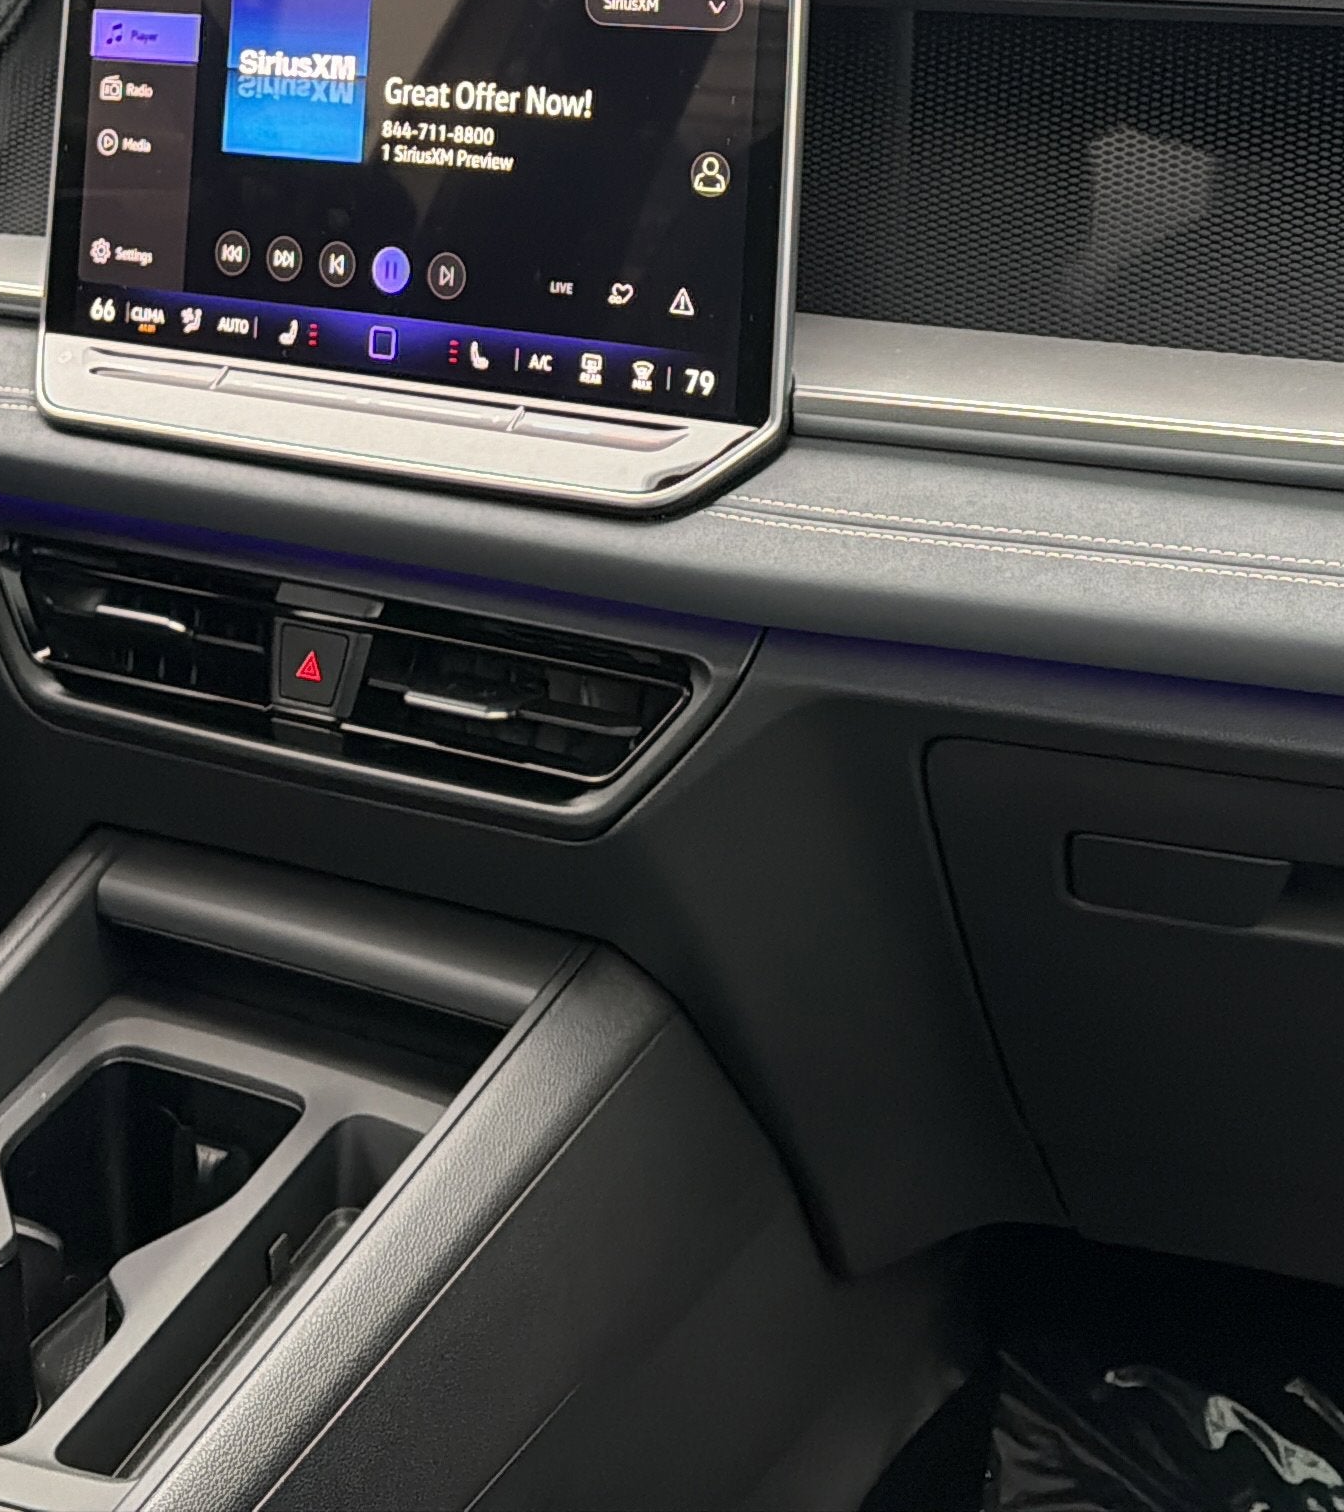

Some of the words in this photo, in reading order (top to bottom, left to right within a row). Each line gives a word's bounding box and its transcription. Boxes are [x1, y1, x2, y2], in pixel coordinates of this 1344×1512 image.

[238, 48, 356, 81] SiriusXM
[125, 82, 154, 99] Radio
[384, 76, 451, 109] Great
[456, 81, 521, 114] Offer
[525, 85, 593, 119] Now!
[381, 119, 495, 146] 844-711-8800
[122, 137, 151, 153] Media
[381, 143, 390, 161] 1
[394, 144, 454, 167] SiriusXM
[457, 149, 515, 172] Preview
[114, 246, 153, 266] Settings
[550, 281, 574, 295] LIVE
[90, 296, 117, 323] 66
[130, 306, 165, 325] CLIMA
[216, 316, 250, 335] AUTO
[528, 353, 553, 372] A/C
[684, 368, 716, 397] 79
